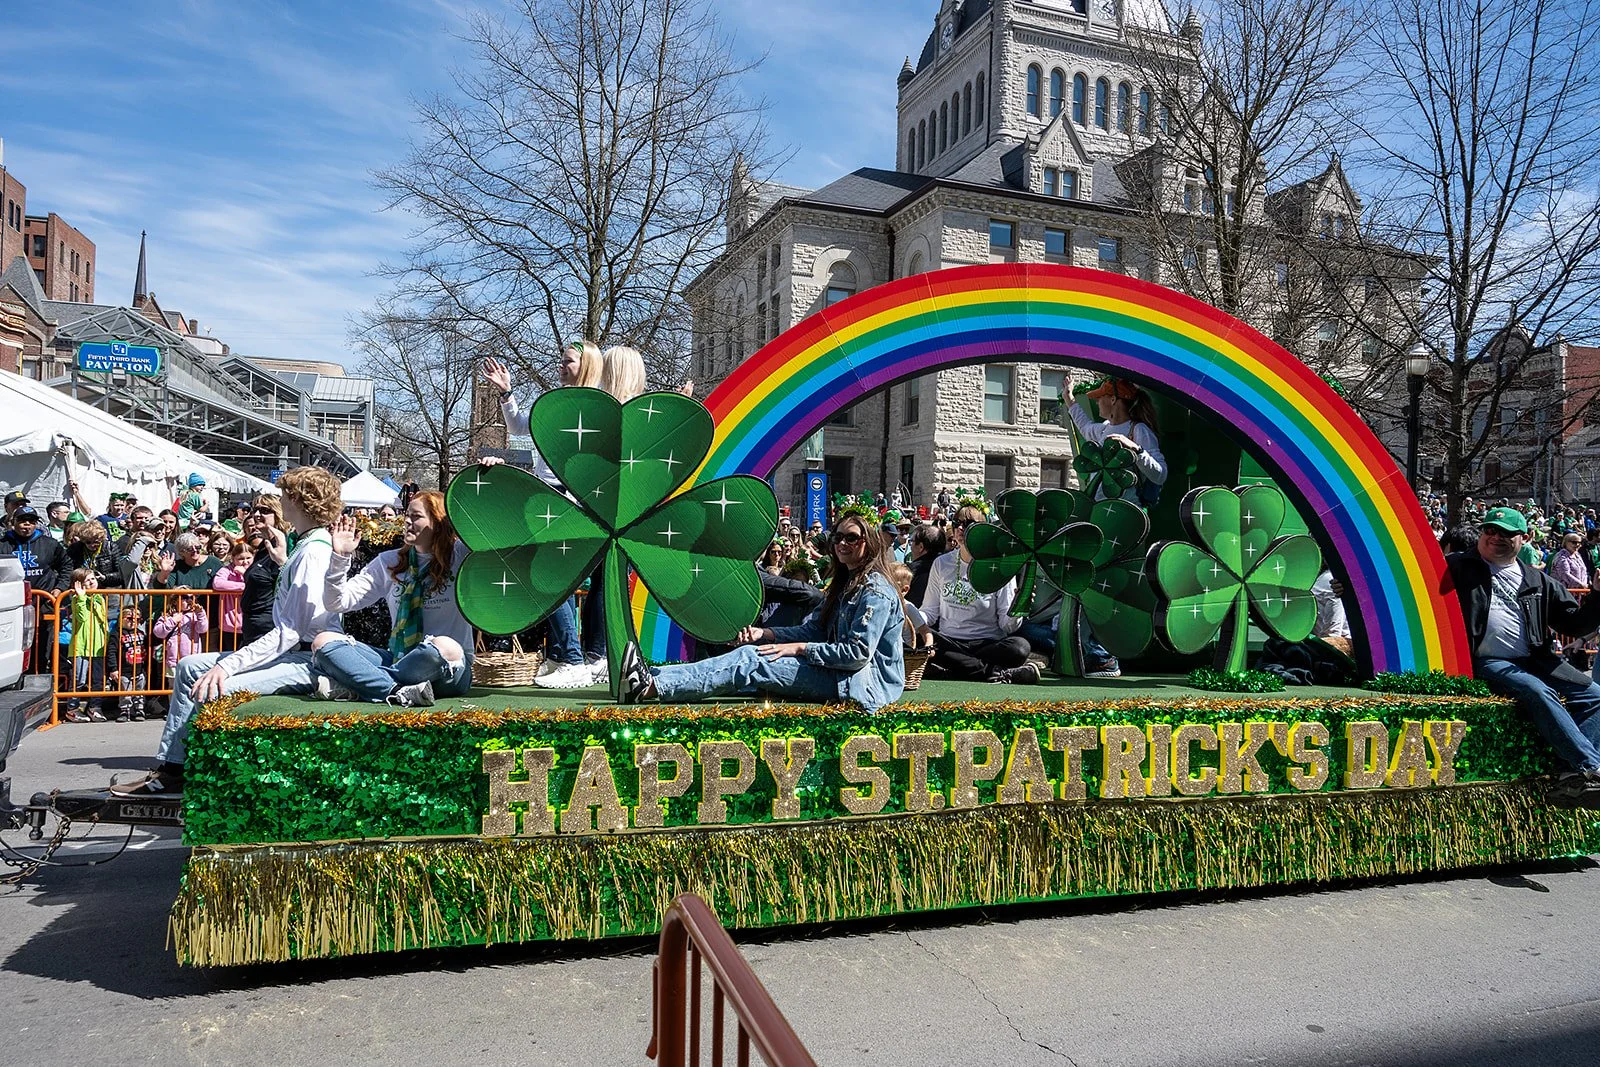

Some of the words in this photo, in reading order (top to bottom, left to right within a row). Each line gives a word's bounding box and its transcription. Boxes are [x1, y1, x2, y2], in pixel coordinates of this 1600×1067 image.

[86, 360, 152, 372] PAVILION
[813, 494, 824, 519] PARK
[482, 738, 815, 835] HAPPY
[1344, 720, 1467, 789] DAY
